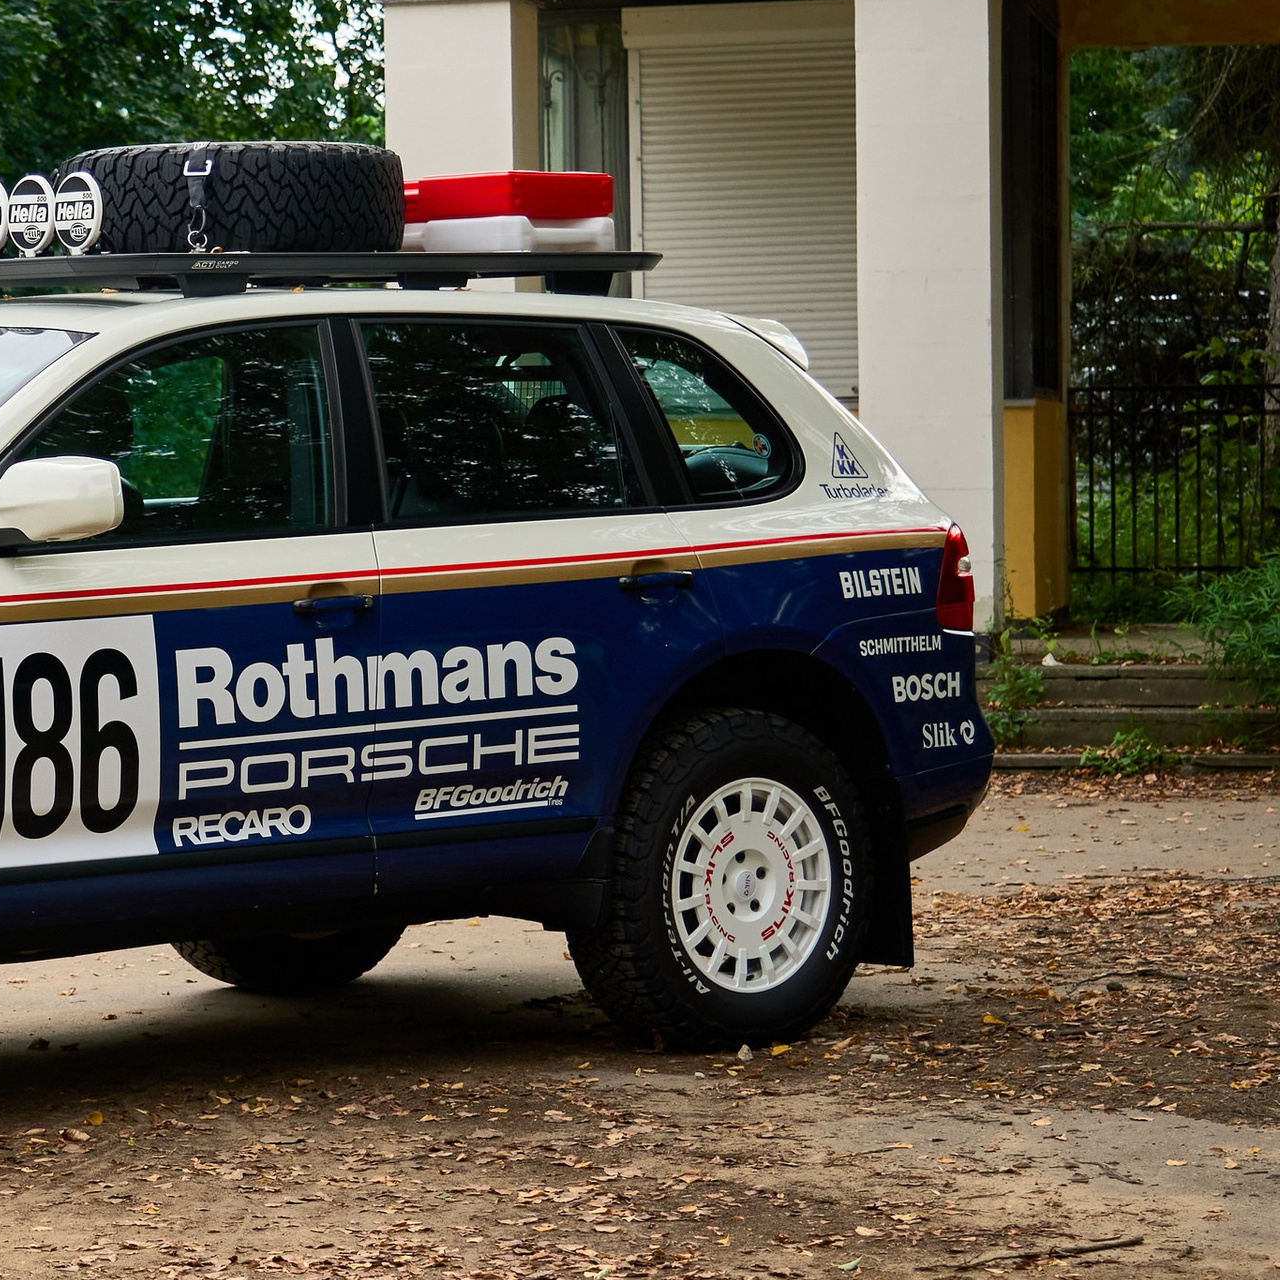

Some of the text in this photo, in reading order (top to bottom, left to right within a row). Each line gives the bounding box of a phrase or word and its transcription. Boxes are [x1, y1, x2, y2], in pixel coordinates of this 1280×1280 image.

[9, 204, 47, 223] Hella
[57, 201, 93, 221] Hella
[835, 444, 849, 459] K
[836, 460, 860, 475] KK
[819, 483, 889, 499] Turbolader
[839, 567, 922, 599] BILSTEIN
[859, 635, 942, 657] SCHMITTHELM
[175, 637, 579, 728] Rothmans
[892, 672, 961, 703] BOSCH
[922, 722, 958, 749] Slik
[179, 724, 580, 800] PORSCHE
[415, 775, 569, 811] BFGoodrich
[548, 797, 563, 806] Tires
[173, 804, 312, 847] RECARO
[813, 785, 854, 961] BFGoodrich
